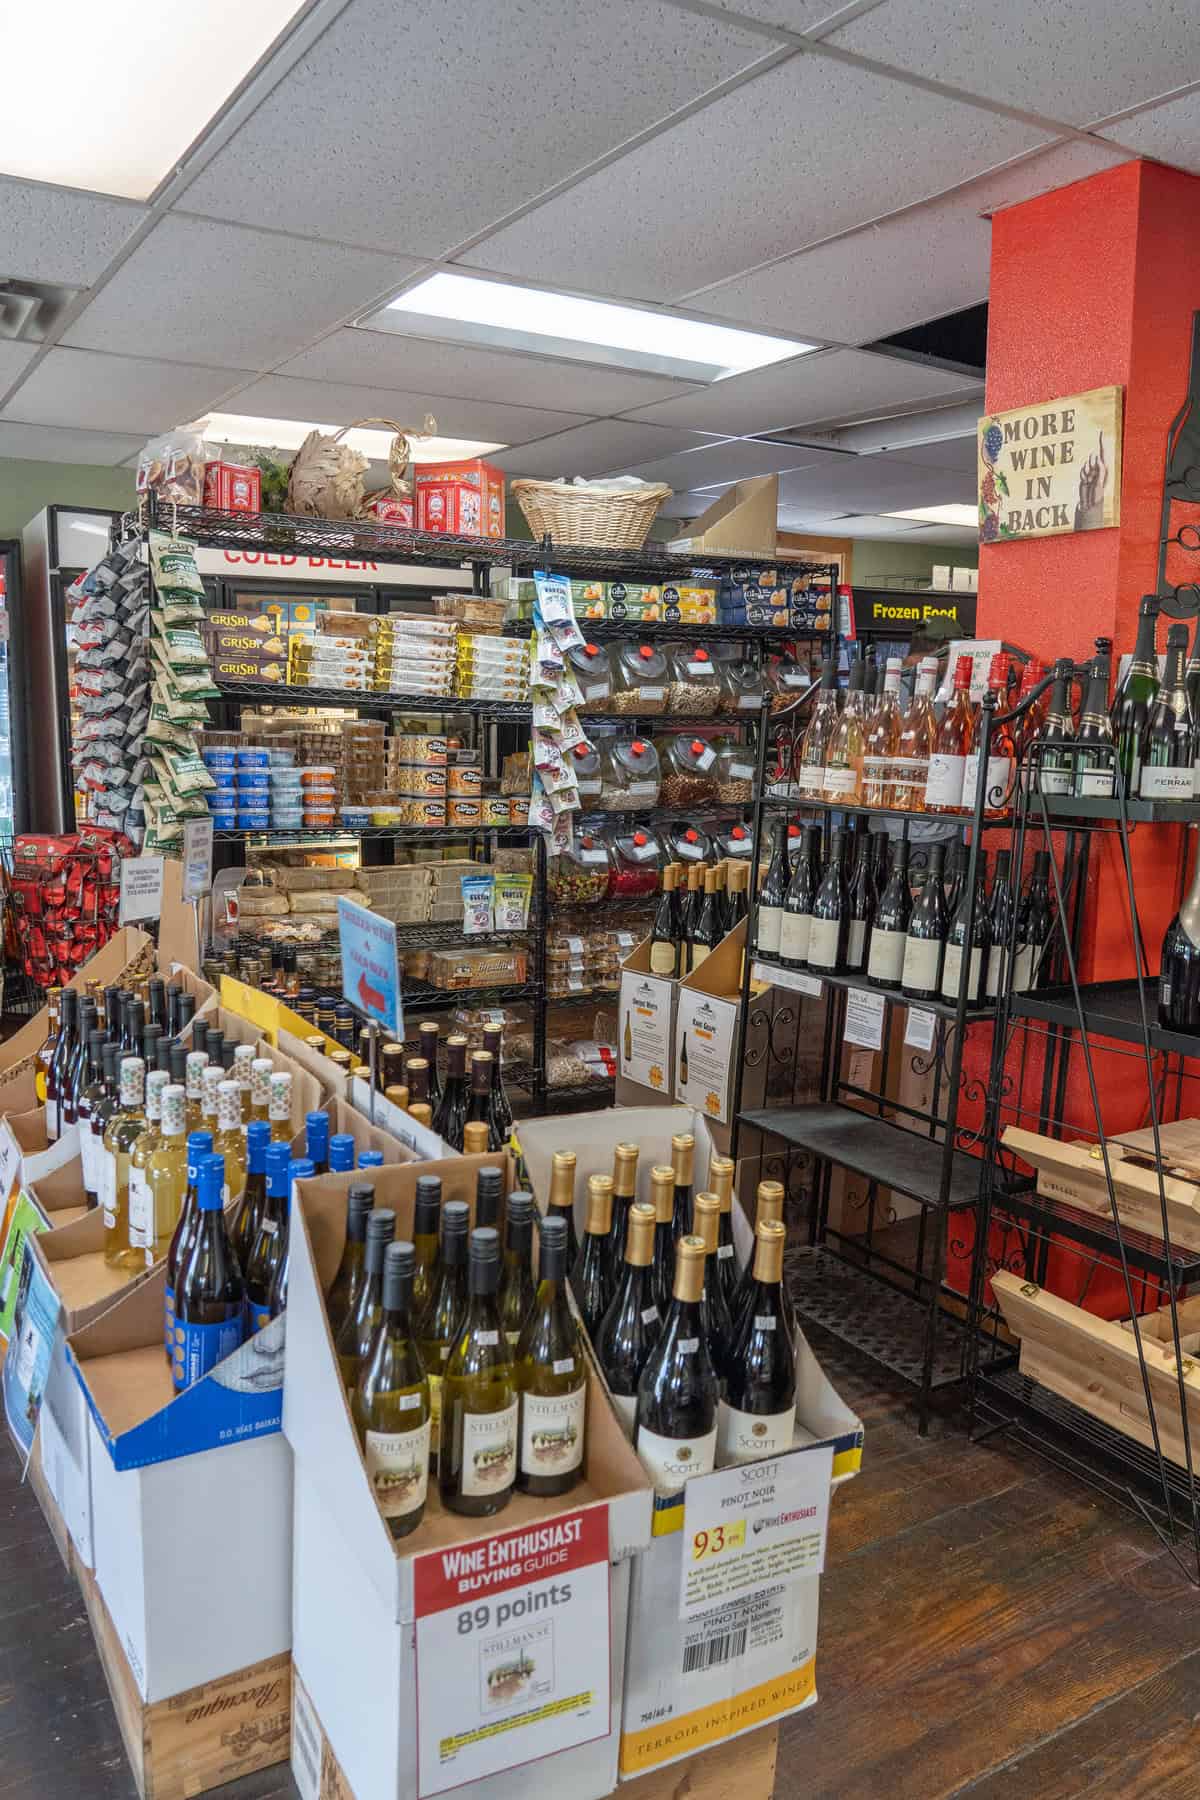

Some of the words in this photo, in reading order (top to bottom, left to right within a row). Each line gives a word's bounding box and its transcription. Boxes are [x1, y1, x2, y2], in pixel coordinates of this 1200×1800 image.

[1003, 409, 1076, 444] MORE
[1010, 440, 1074, 471] WINE
[1025, 475, 1053, 500] IN
[1008, 504, 1070, 531] BACK
[223, 549, 297, 565] COLD
[873, 603, 920, 619] Frozen
[721, 1493, 751, 1508] PINOT
[752, 1486, 776, 1499] NOIR
[442, 1547, 486, 1581] WINE
[488, 1518, 583, 1568] ENTHUSIAST
[693, 1526, 725, 1560] 93
[458, 1563, 522, 1593] BUYING
[523, 1548, 568, 1573] GUIDE
[456, 1605, 490, 1635] 89
[496, 1583, 572, 1627] points
[703, 1611, 739, 1629] PINOT
[637, 1726, 700, 1755] TERROIR
[705, 1697, 767, 1729] INSPIRED
[771, 1679, 809, 1701] WINES
